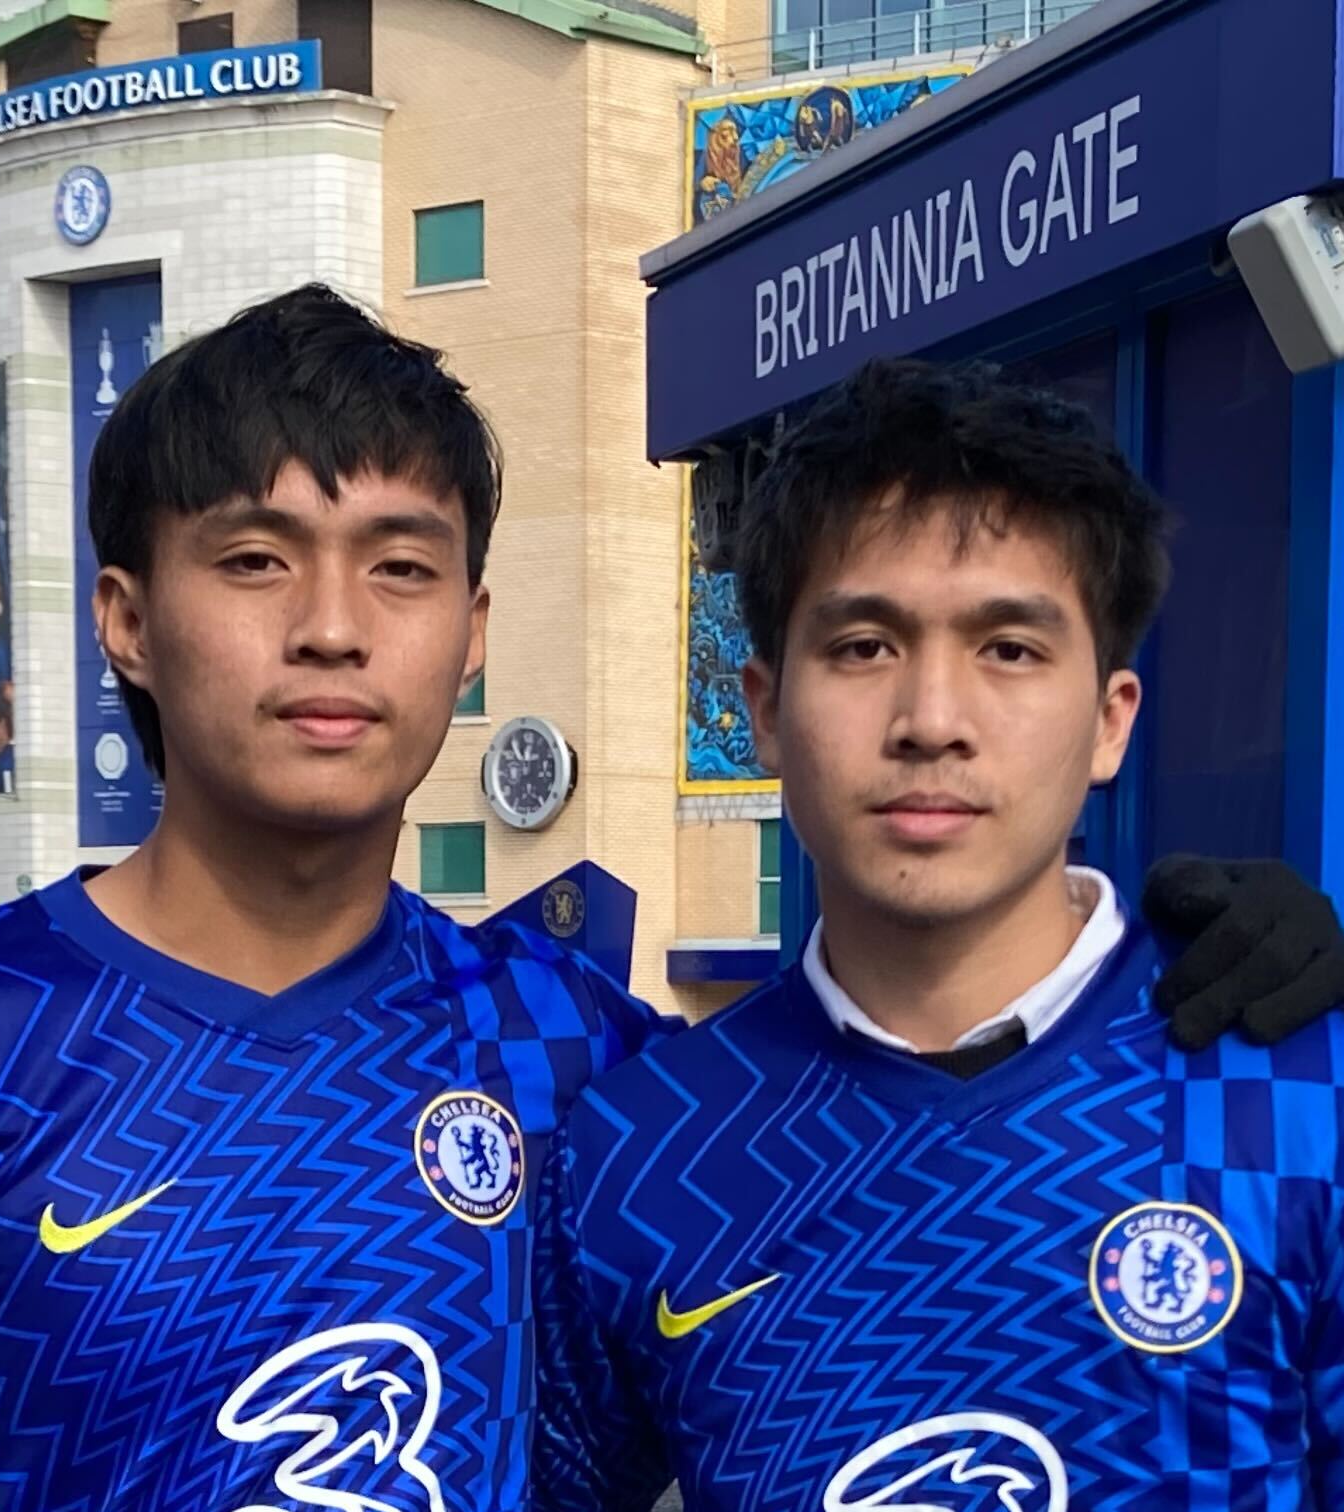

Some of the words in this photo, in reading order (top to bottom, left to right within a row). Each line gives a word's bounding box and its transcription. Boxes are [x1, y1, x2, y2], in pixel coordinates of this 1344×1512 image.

[49, 63, 204, 120] FOOTBALL
[209, 51, 303, 95] CLUB
[755, 179, 985, 380] BRITANNIA
[999, 94, 1141, 268] GATE
[430, 1099, 502, 1127] CHELSEA
[448, 1191, 494, 1215] FOOTBALL
[1123, 1213, 1210, 1248] CHELSEA
[1117, 1305, 1172, 1340] FOOTBALL
